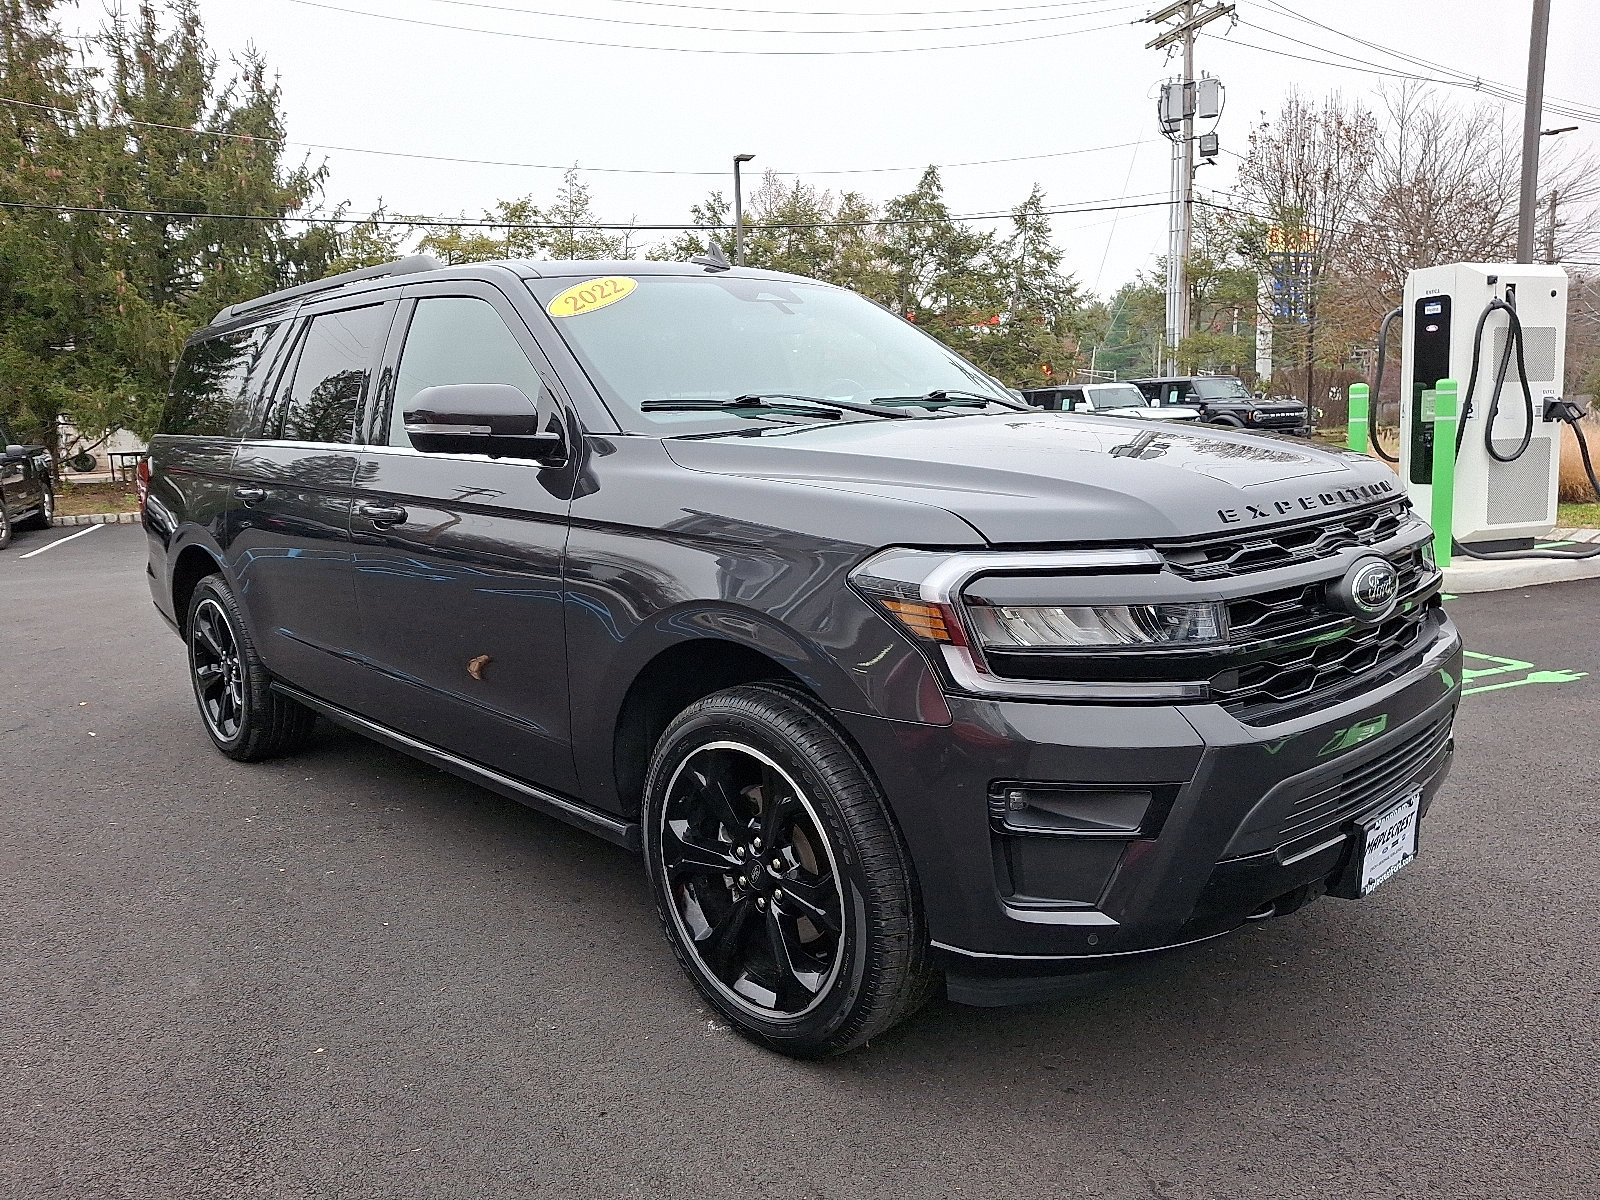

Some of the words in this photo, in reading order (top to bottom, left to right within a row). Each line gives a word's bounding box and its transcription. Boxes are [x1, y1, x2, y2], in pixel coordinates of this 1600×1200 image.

[564, 280, 625, 312] 2022
[1217, 480, 1394, 525] EXPEDITION
[1368, 573, 1396, 602] Ford
[1365, 811, 1415, 854] MAPLECREST
